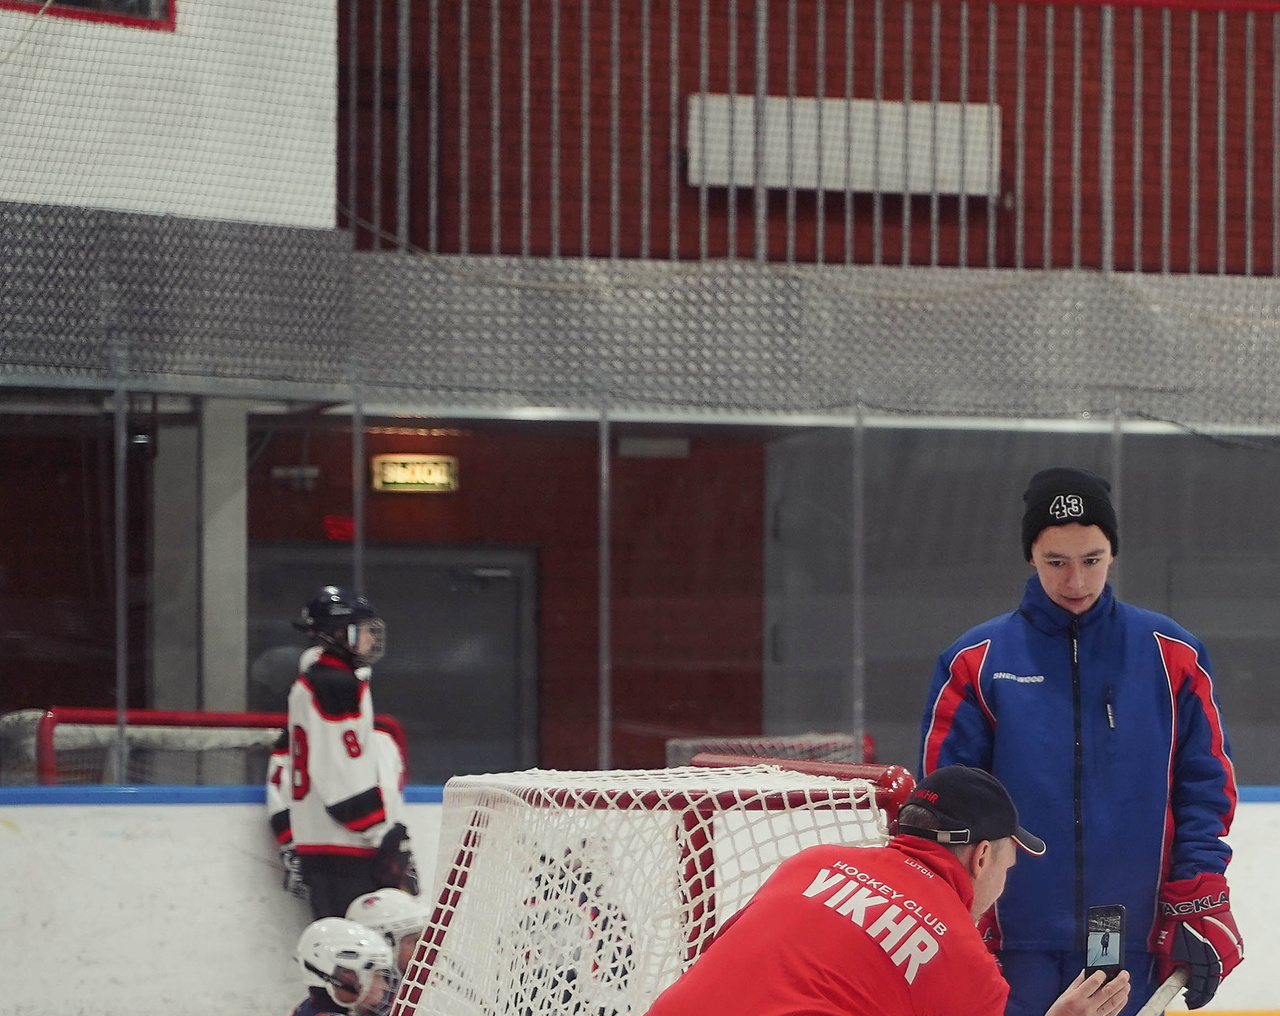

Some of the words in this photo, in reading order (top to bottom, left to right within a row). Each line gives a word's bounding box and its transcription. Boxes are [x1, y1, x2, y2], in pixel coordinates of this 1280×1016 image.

[1049, 495, 1084, 519] 43
[904, 858, 934, 879] LUTCH
[833, 860, 904, 900] HOCKEY
[903, 899, 947, 936] CLUB
[802, 868, 939, 985] VIKHR
